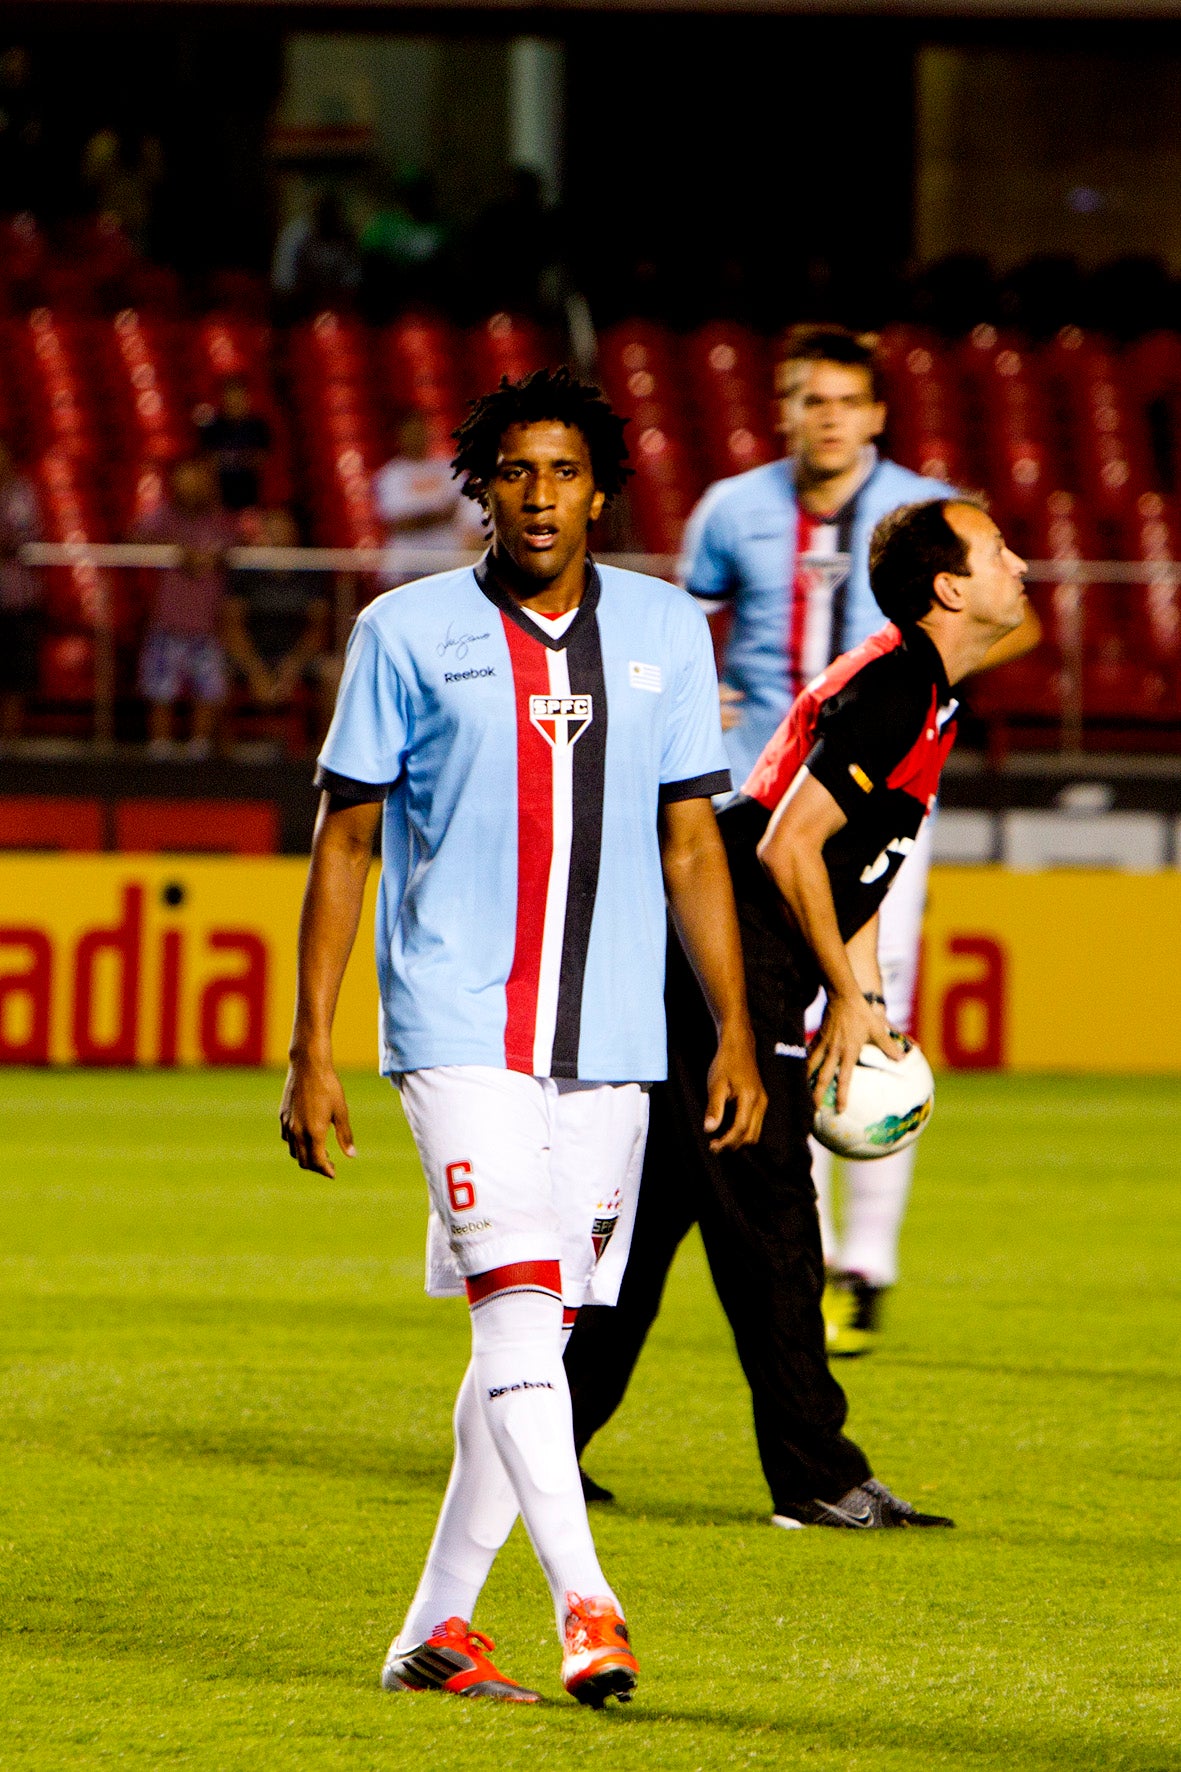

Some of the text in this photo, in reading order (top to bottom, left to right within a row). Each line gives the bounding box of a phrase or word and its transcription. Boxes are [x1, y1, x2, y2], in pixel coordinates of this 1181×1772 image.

[444, 666, 496, 683] Reebok
[533, 699, 588, 714] SPFC
[0, 880, 268, 1067] adia
[445, 1160, 475, 1212] 6
